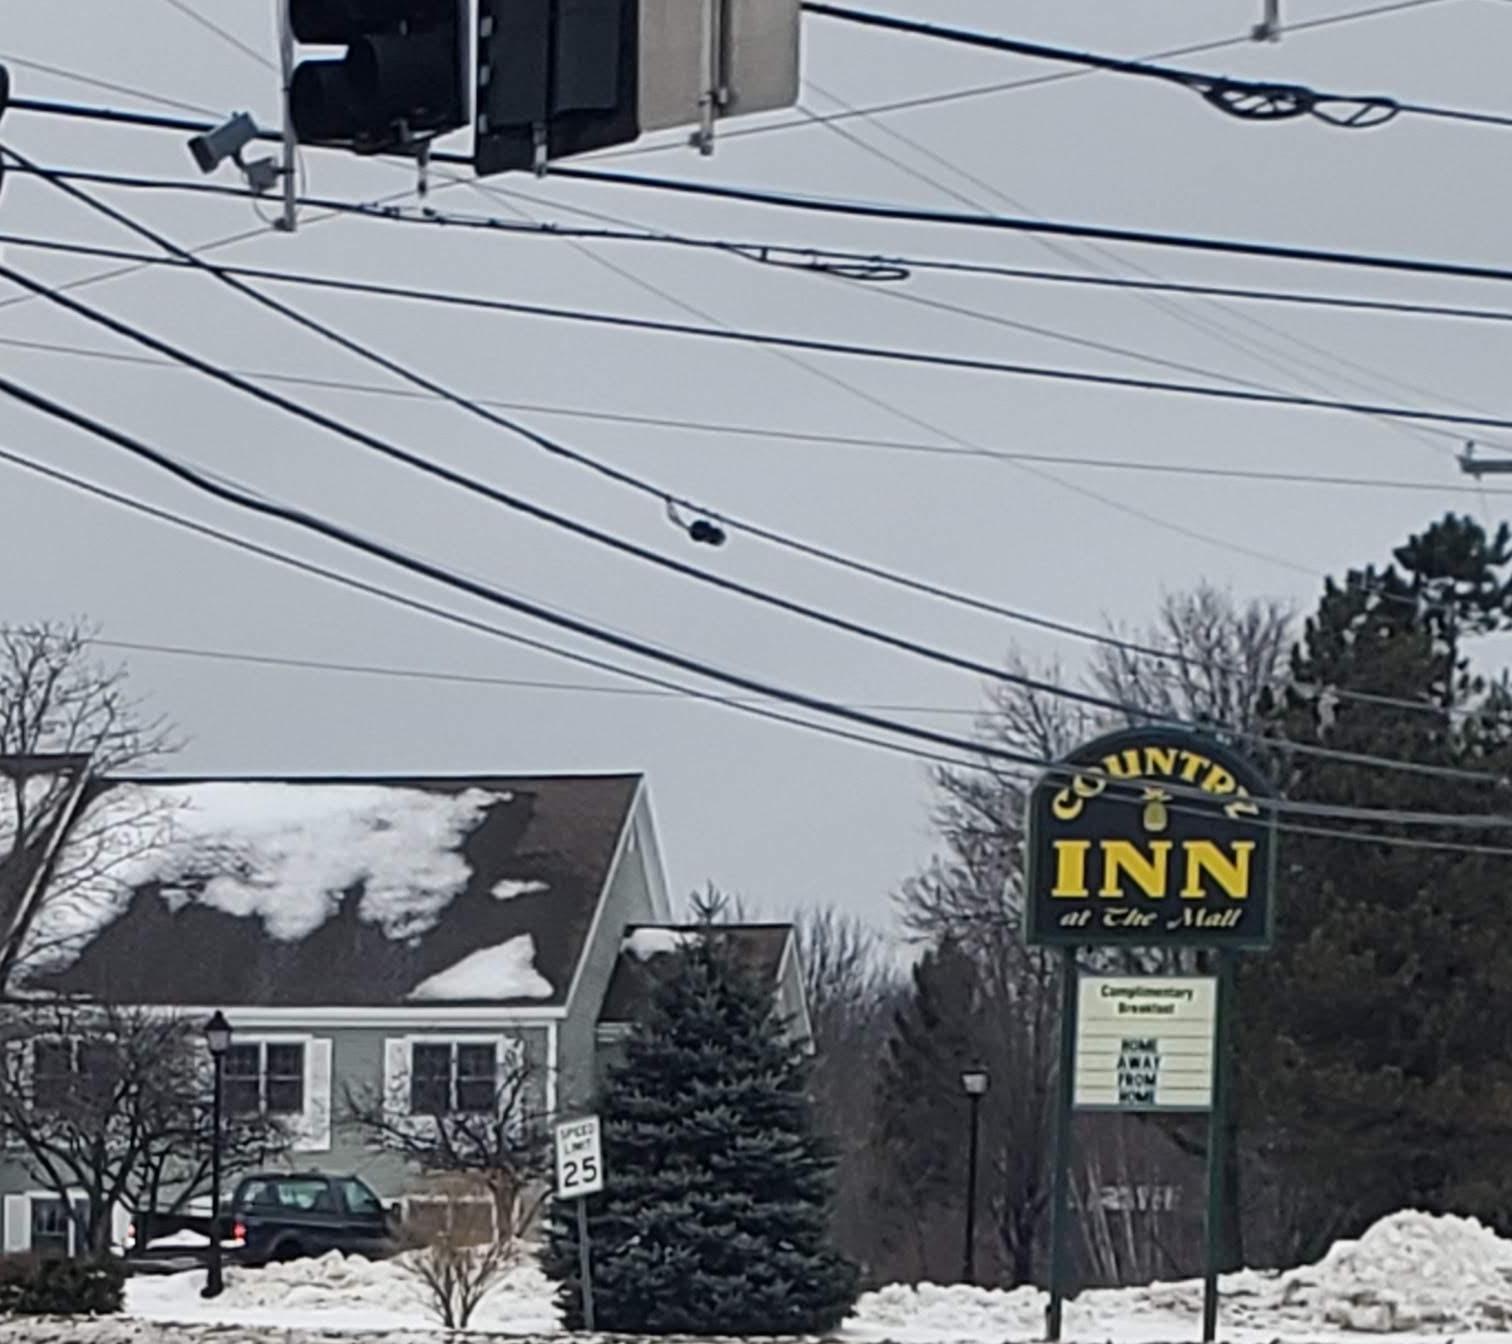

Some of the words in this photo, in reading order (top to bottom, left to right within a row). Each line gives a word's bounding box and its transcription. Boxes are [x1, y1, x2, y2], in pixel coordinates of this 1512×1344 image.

[1052, 747, 1259, 820] COUNTRY
[1051, 839, 1256, 898] INN
[1060, 908, 1091, 927] at
[1103, 907, 1157, 927] The
[1166, 907, 1243, 930] Mall
[1100, 984, 1194, 1001] Complimentary
[1116, 1055, 1162, 1069] AWAY
[1117, 1072, 1156, 1087] FROM
[560, 1122, 594, 1139] SPEED
[564, 1138, 591, 1154] LIMIT
[563, 1155, 597, 1188] 25
